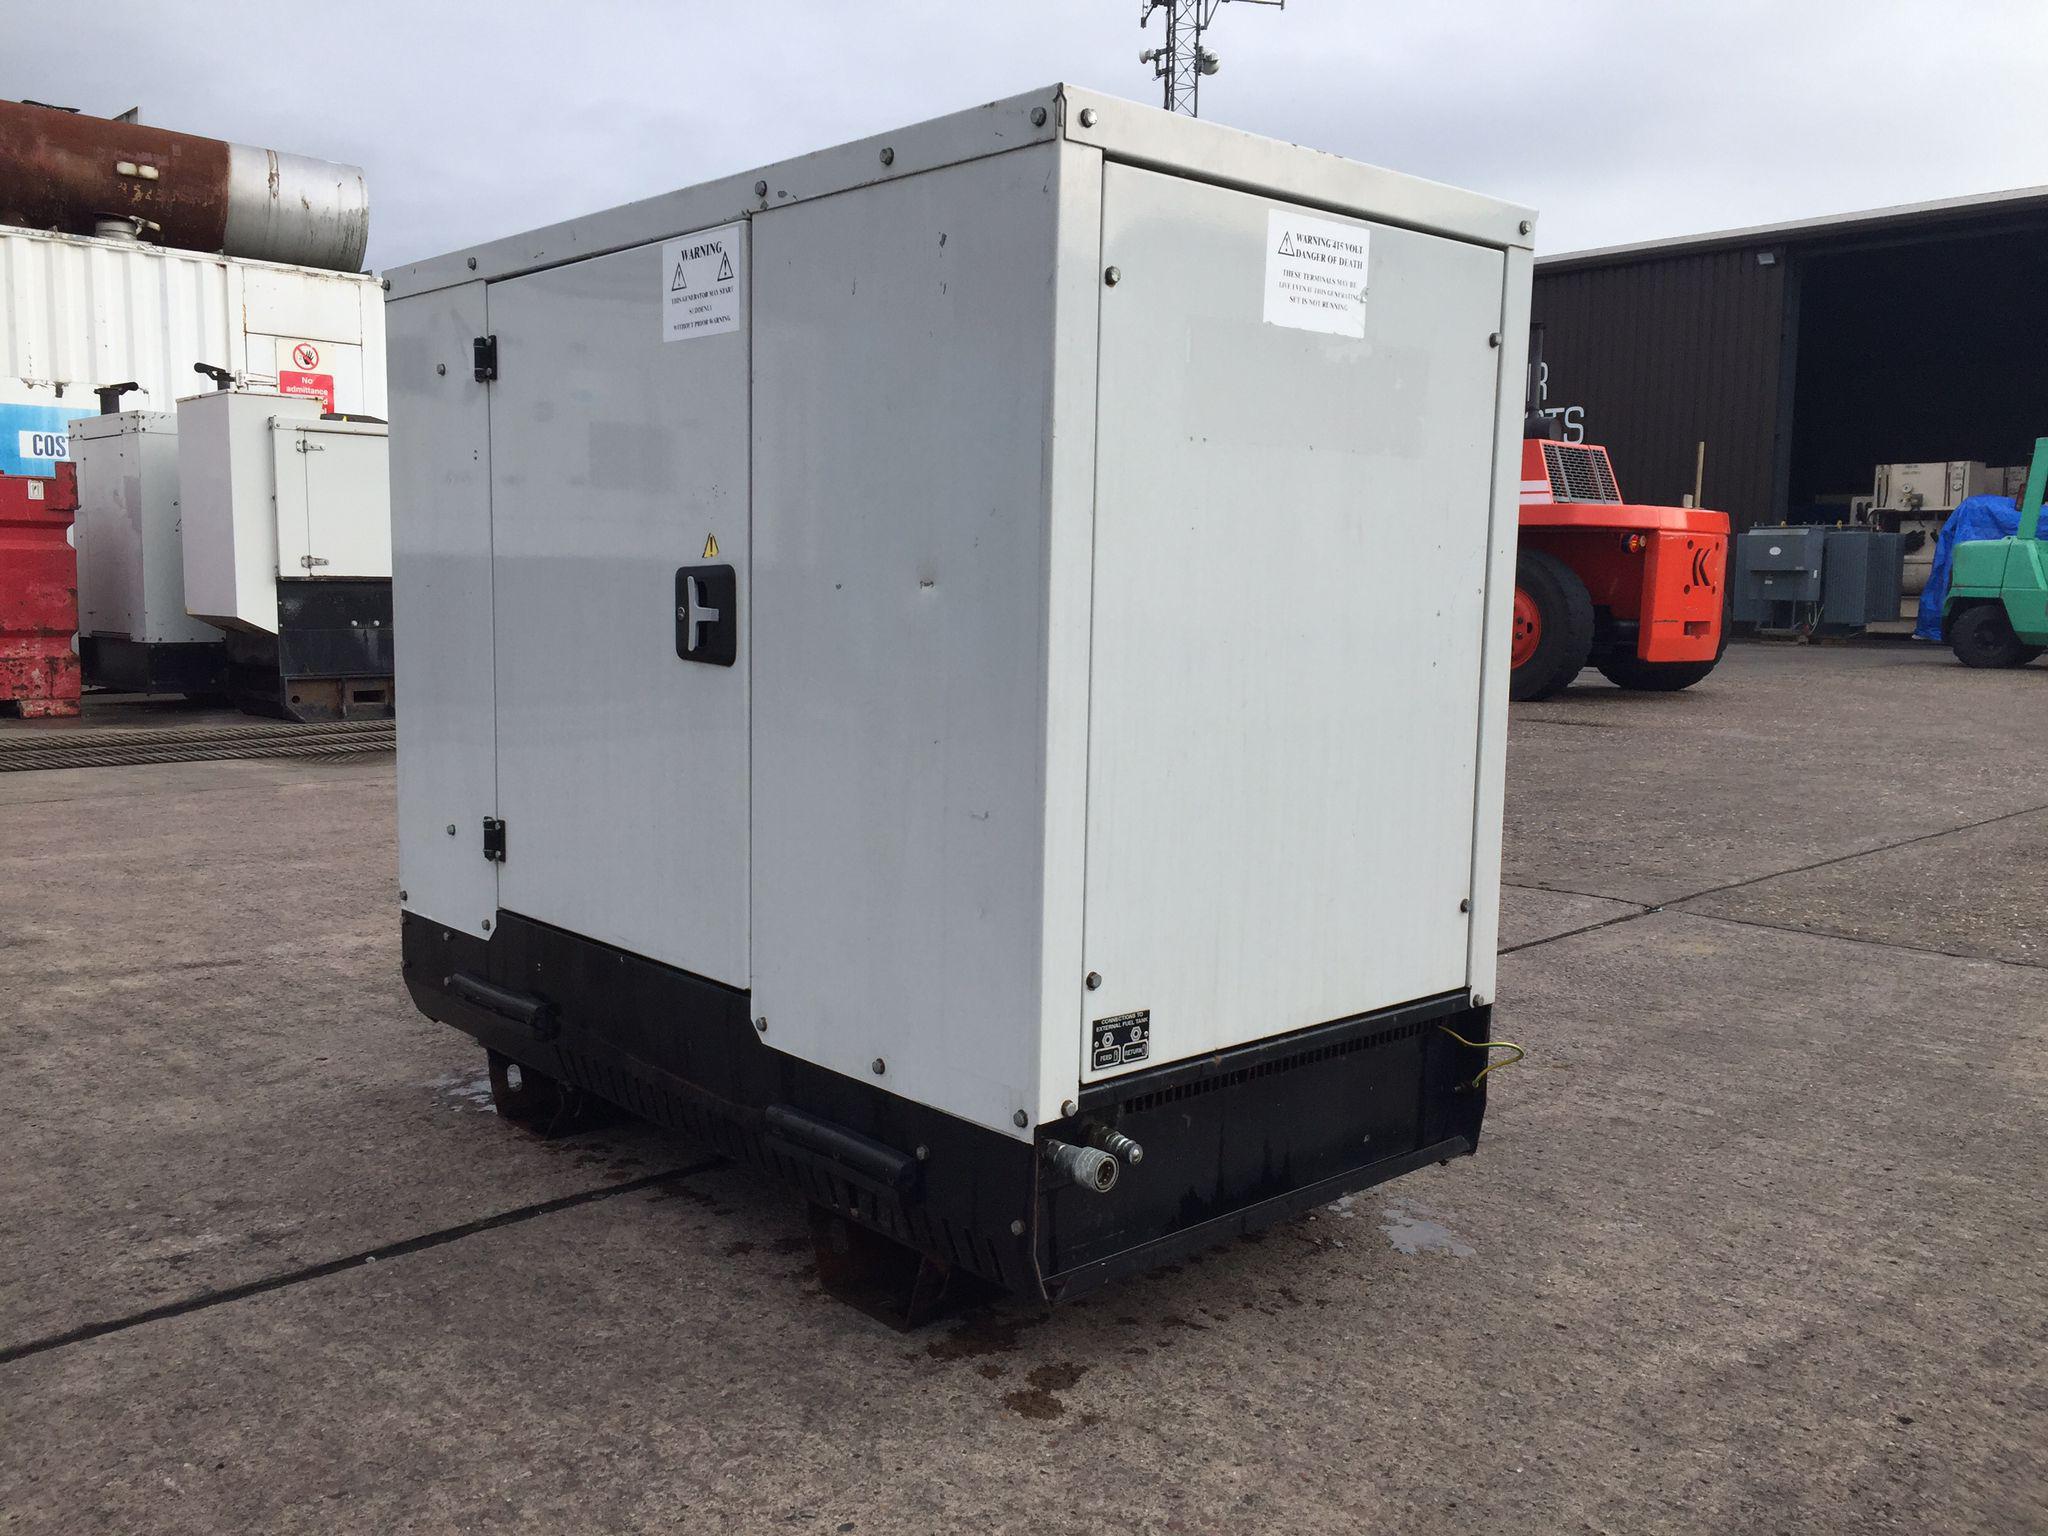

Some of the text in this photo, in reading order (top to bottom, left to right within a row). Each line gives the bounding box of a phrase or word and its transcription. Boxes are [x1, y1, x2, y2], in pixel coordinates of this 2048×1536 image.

[1296, 233, 1363, 254] WARNING 415 VOLT
[681, 241, 722, 261] WARNING
[1296, 249, 1363, 269] DANGER OF DEATH
[1283, 269, 1301, 278] THESE
[1303, 272, 1336, 284] TERMINALS
[1279, 281, 1290, 289] LIVE
[1309, 299, 1321, 307] NOT
[1322, 301, 1348, 311] RUNNING
[286, 385, 328, 395] admittance
[33, 434, 69, 458] COS
[1101, 1014, 1136, 1025] CONNECTIONS
[1096, 1023, 1121, 1032] EXTERNAL
[1125, 1048, 1142, 1056] RETURN
[1100, 1054, 1112, 1062] FEED
